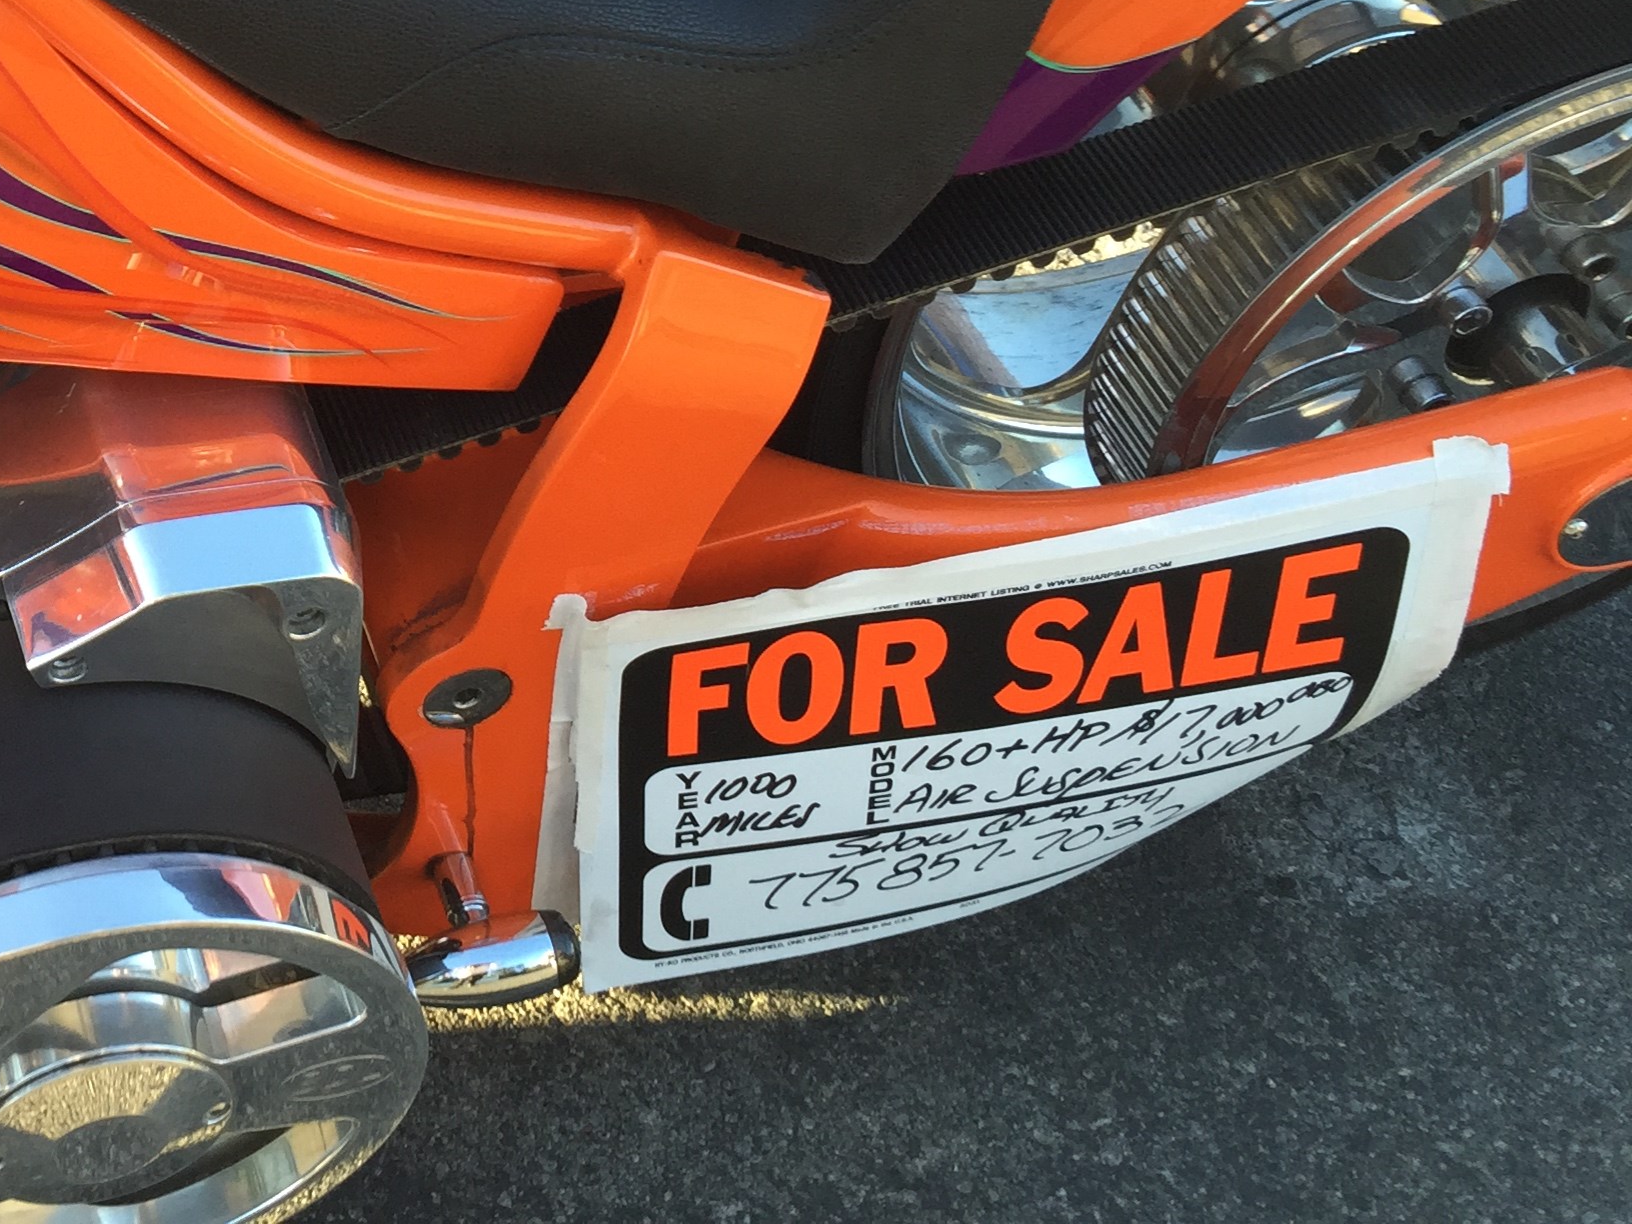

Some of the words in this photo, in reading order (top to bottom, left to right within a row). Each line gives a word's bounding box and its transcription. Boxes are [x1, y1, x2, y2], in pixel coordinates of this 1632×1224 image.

[936, 590, 988, 604] INTERNET
[990, 584, 1031, 597] LISTING
[1046, 560, 1174, 588] WWW.SHARPSALES.COM
[667, 617, 948, 758] FOR
[993, 542, 1363, 715] SALE
[704, 771, 798, 805] 1000
[866, 744, 897, 826] MODEL
[893, 782, 977, 814] AIR
[984, 724, 1302, 804] SUSPENSION
[674, 770, 703, 849] YEAR
[700, 802, 821, 838] MILES
[979, 786, 1176, 838] QUALITY
